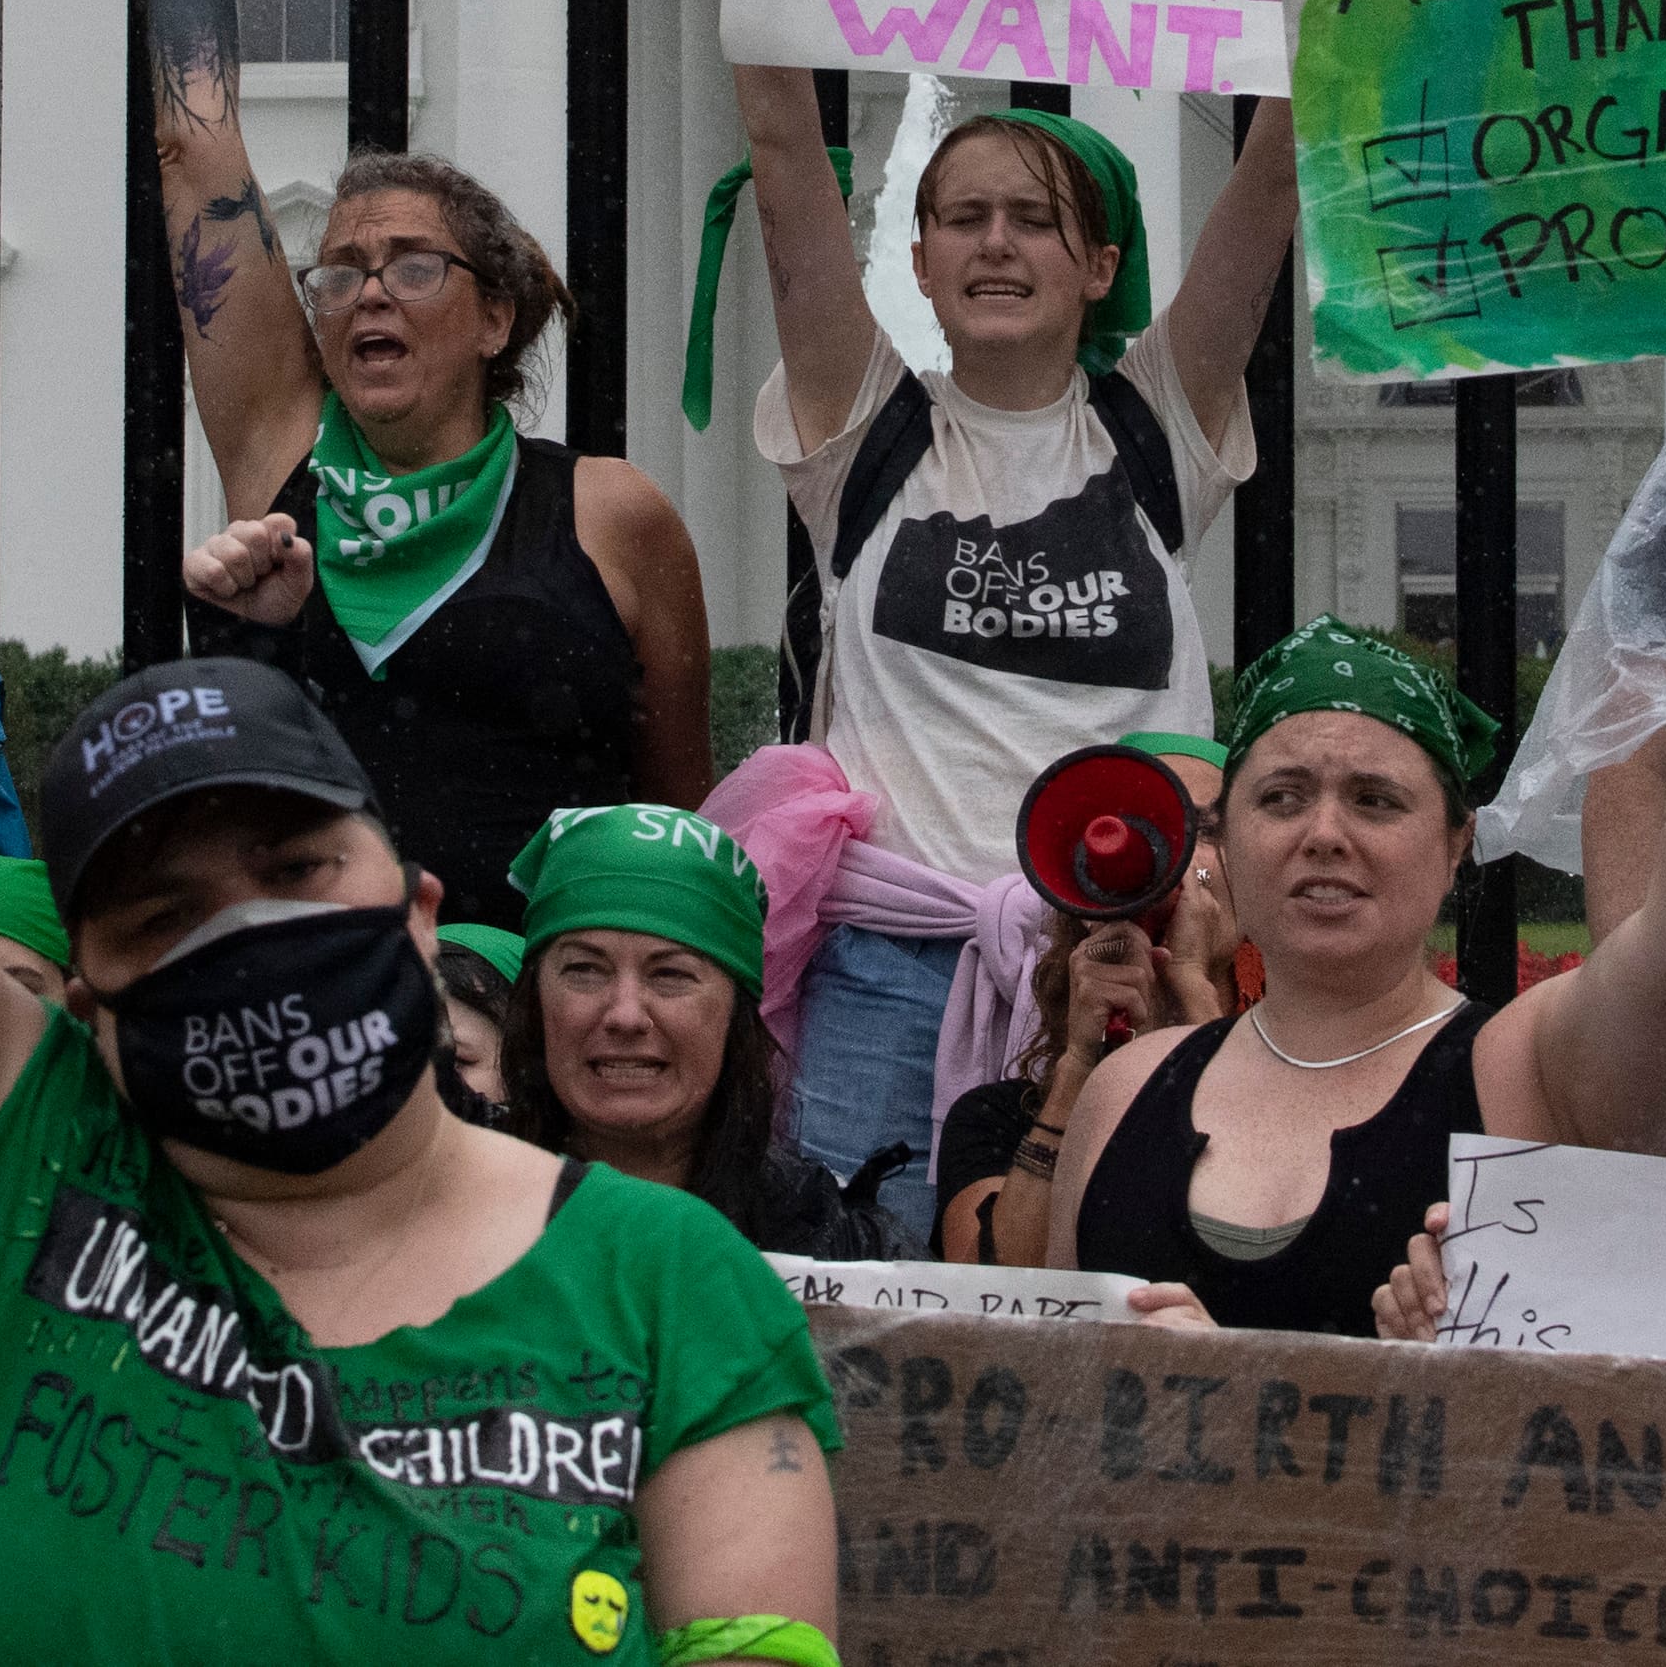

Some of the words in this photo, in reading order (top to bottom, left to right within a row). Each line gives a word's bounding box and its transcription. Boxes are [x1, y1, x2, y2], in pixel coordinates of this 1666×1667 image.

[946, 566, 1021, 605] OFF
[1029, 571, 1131, 612] OUR
[955, 537, 1049, 586] BANS
[944, 599, 1118, 638] BODIES
[82, 687, 230, 772] HOPE
[183, 1047, 279, 1096] OFF
[287, 1009, 399, 1079] OUR
[186, 993, 311, 1054] BANS
[1441, 1144, 1559, 1242] Is
[306, 1519, 524, 1637] KIDS
